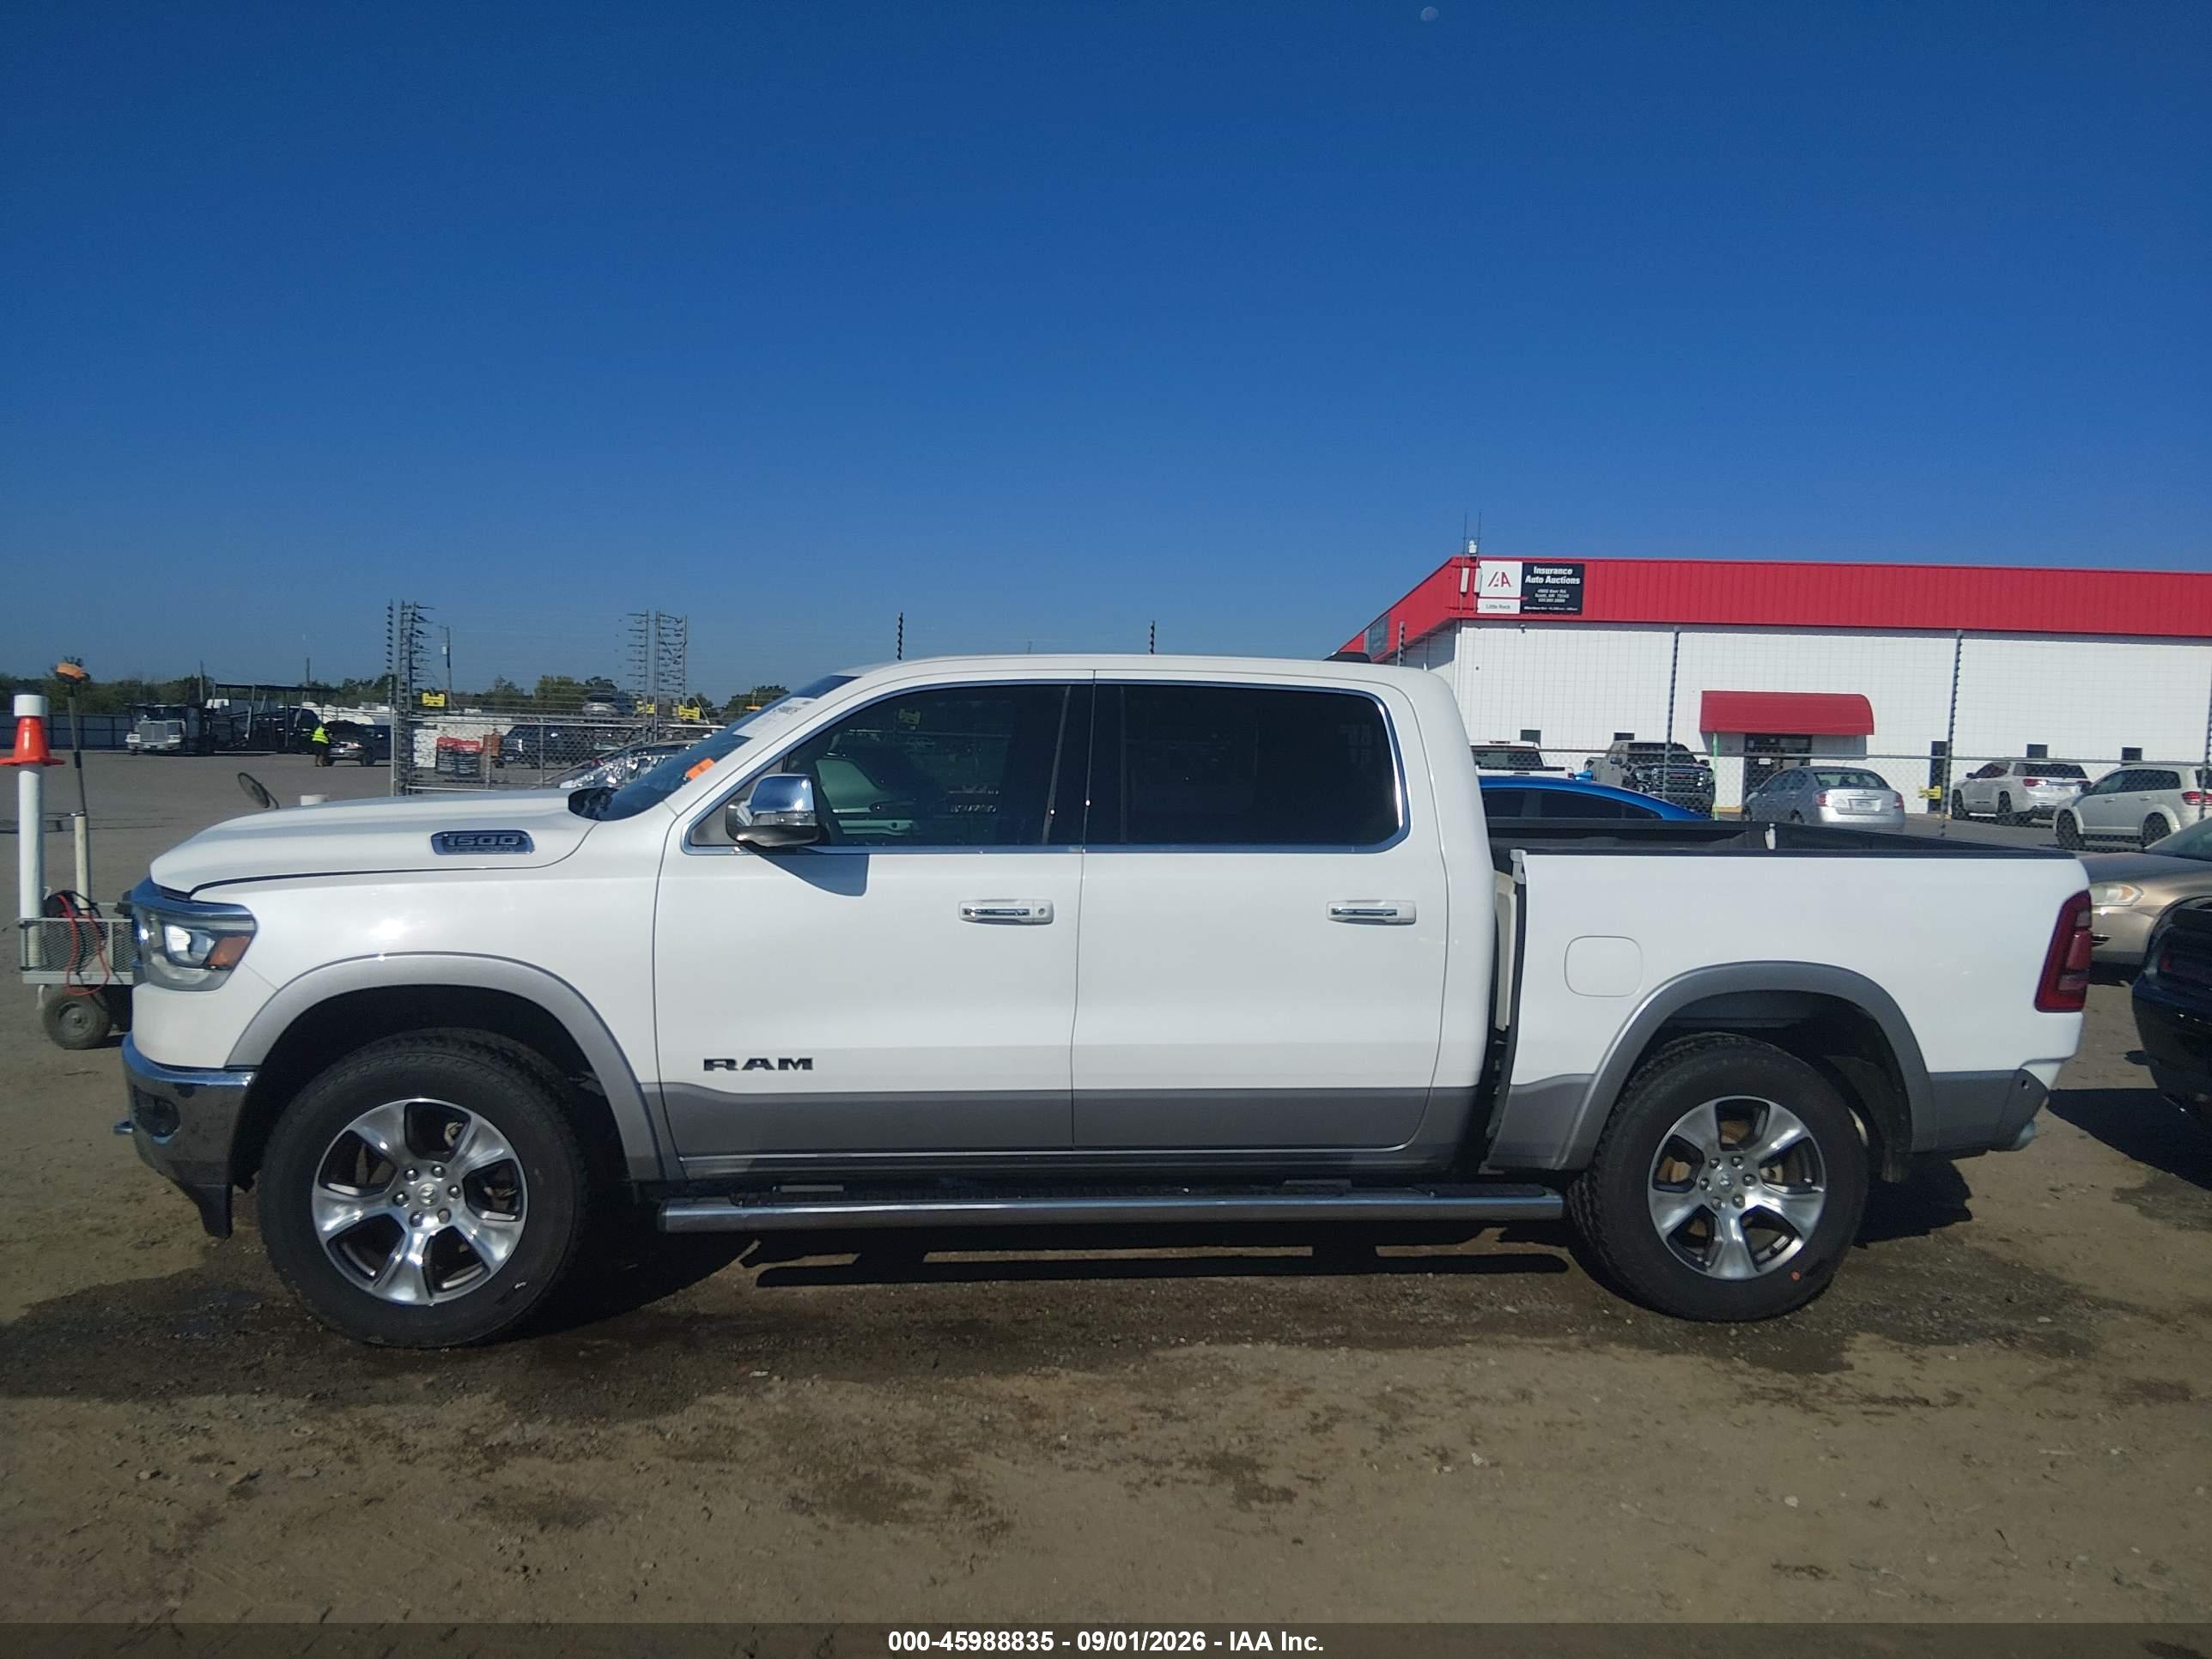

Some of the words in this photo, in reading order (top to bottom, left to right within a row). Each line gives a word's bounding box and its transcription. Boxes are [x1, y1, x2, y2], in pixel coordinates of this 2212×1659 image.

[1534, 566, 1573, 575] Insurance
[1525, 574, 1544, 584] Auto
[1545, 575, 1581, 585] Auctions
[447, 836, 520, 846] 1500
[703, 1058, 813, 1072] RAM
